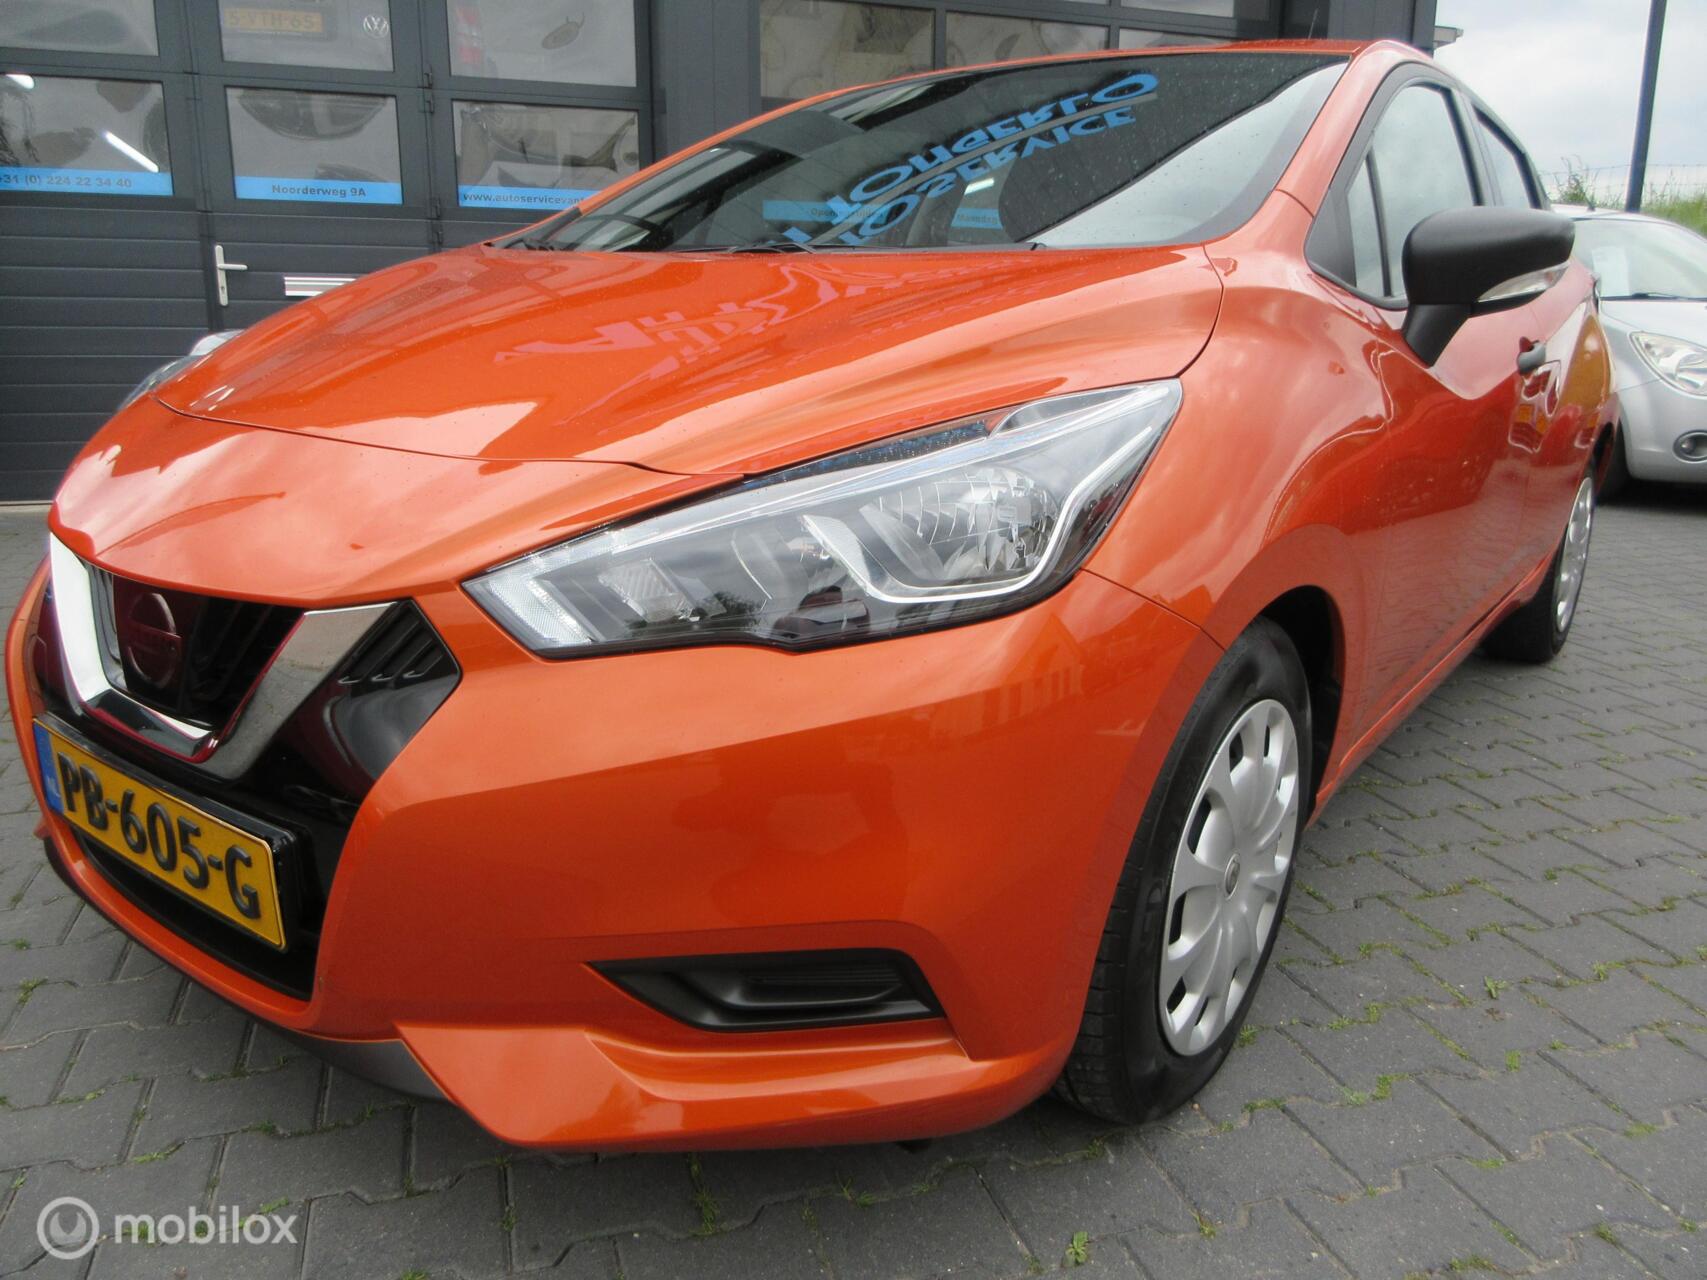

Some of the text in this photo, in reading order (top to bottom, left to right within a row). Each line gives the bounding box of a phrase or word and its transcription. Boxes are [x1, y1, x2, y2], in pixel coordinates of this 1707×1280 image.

[25, 175, 41, 185] (0)
[47, 176, 71, 186] 224
[76, 177, 91, 186] 22
[96, 178, 111, 187] 34
[116, 178, 132, 188] 40
[272, 184, 366, 198] Noorderweg 9A
[57, 751, 261, 920] PB-605-G
